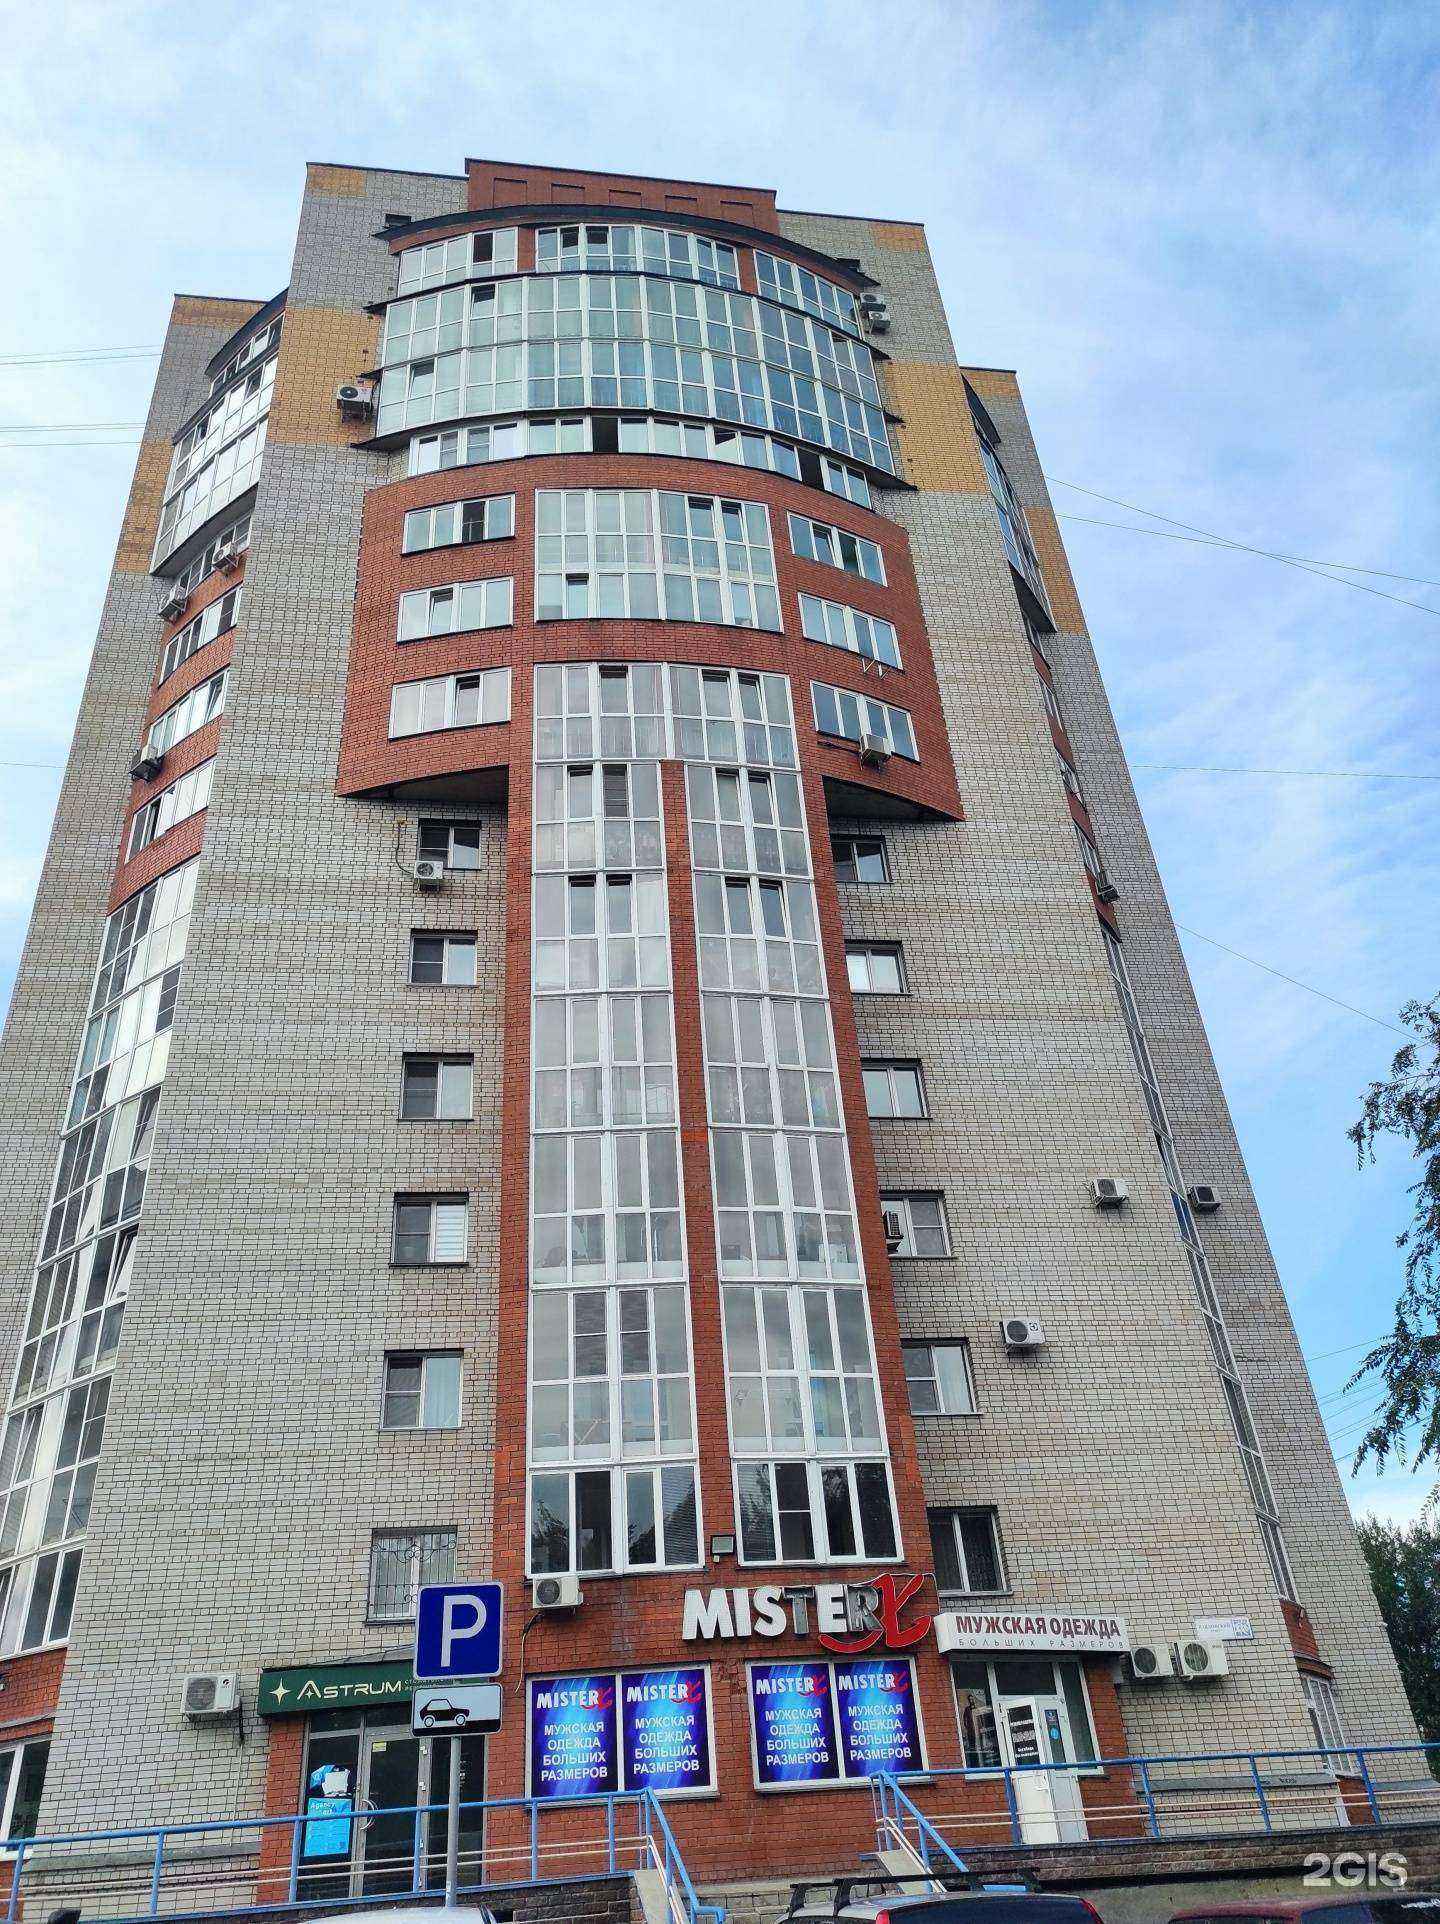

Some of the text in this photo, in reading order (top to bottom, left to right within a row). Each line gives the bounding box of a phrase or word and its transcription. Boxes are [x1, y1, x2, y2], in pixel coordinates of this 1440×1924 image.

[682, 1583, 883, 1640] MISTER
[440, 1594, 488, 1668] P
[955, 1615, 1122, 1639] МУЖСКАЯ ОДЕЖДА
[958, 1638, 1126, 1649] БОЛЬШИХ РАЗМЕРОВ
[755, 1676, 814, 1695] MISTER
[838, 1673, 896, 1691] MISTER
[536, 1690, 599, 1709] MISTER
[626, 1683, 688, 1703] MISTER
[765, 1708, 822, 1721] МУЖСКАЯ
[848, 1704, 904, 1717] МУЖСКАЯ
[544, 1721, 605, 1736] МУЖСКАЯ
[635, 1715, 695, 1729] МУЖСКАЯ
[852, 1719, 903, 1732] ОДЕЖДА
[638, 1730, 692, 1745] ОДЕЖДА
[769, 1723, 821, 1737] ОДЕЖДА
[547, 1738, 601, 1752] ОДЕЖДА
[766, 1737, 827, 1751] БОЛЬШИХ
[850, 1732, 909, 1746] БОЛЬШИХ
[543, 1751, 607, 1766] БОЛЬШИХ
[634, 1744, 698, 1760] БОЛЬШИХ
[766, 1752, 830, 1766] РАЗМЕРОВ
[850, 1747, 912, 1761] РАЗМЕРОВ
[541, 1767, 608, 1782] РАЗМЕРОВ
[633, 1760, 700, 1775] РАЗМЕРОВ
